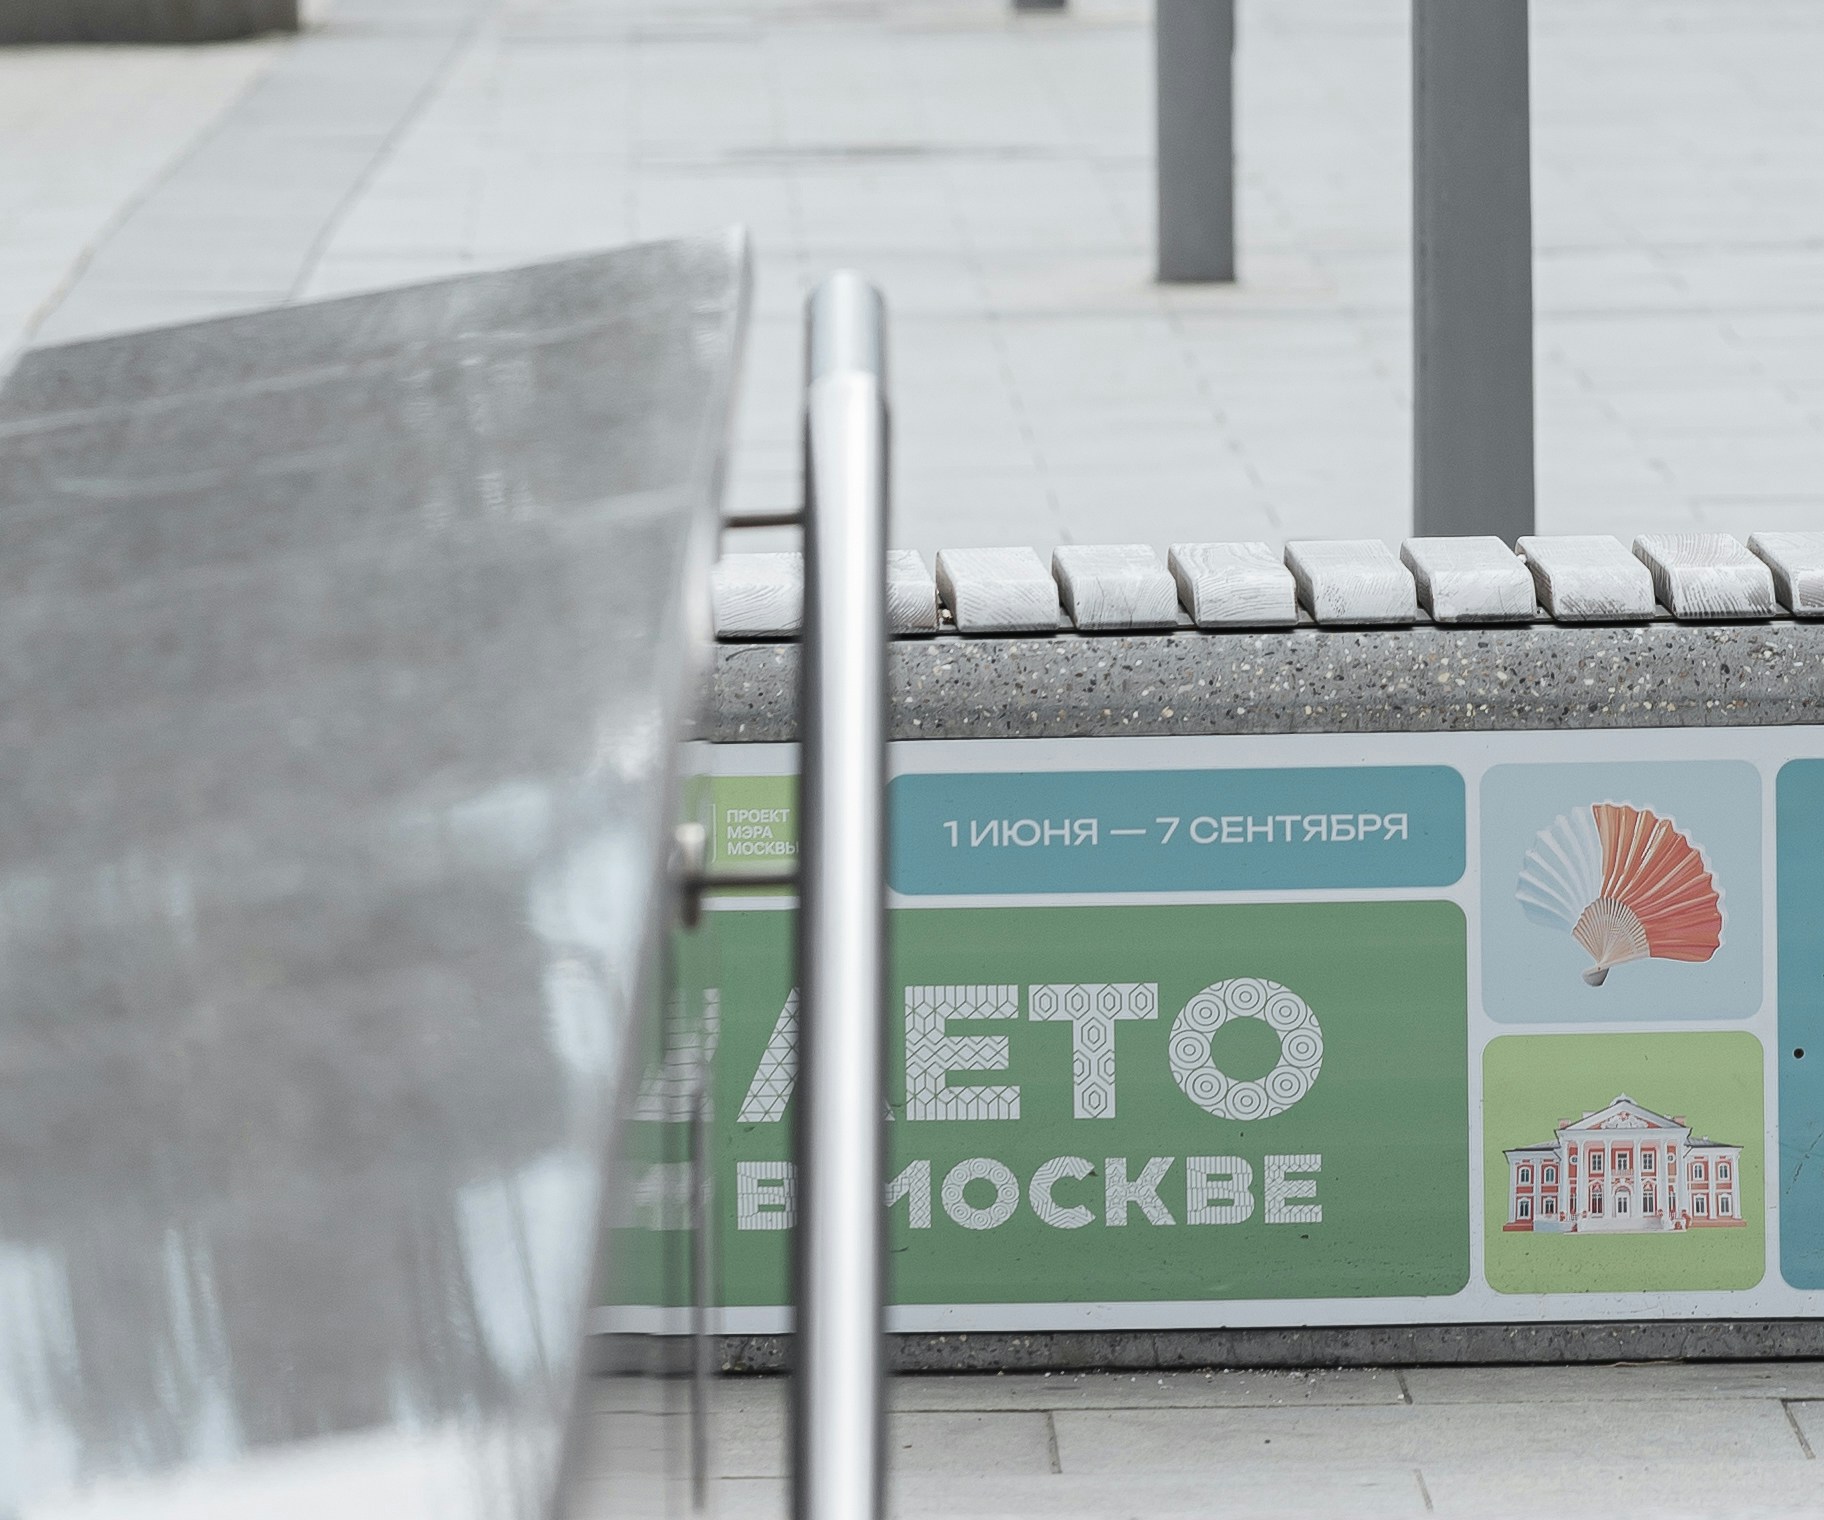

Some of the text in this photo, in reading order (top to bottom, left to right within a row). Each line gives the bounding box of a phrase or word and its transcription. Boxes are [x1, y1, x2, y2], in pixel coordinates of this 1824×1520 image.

[726, 809, 790, 824] ПРОЕКТ
[727, 825, 774, 840] МЭРА
[943, 819, 957, 847] 1
[970, 817, 1099, 847] ИЮНЯ
[1156, 817, 1179, 845] 7
[1190, 812, 1409, 845] СЕНТЯБРЯ
